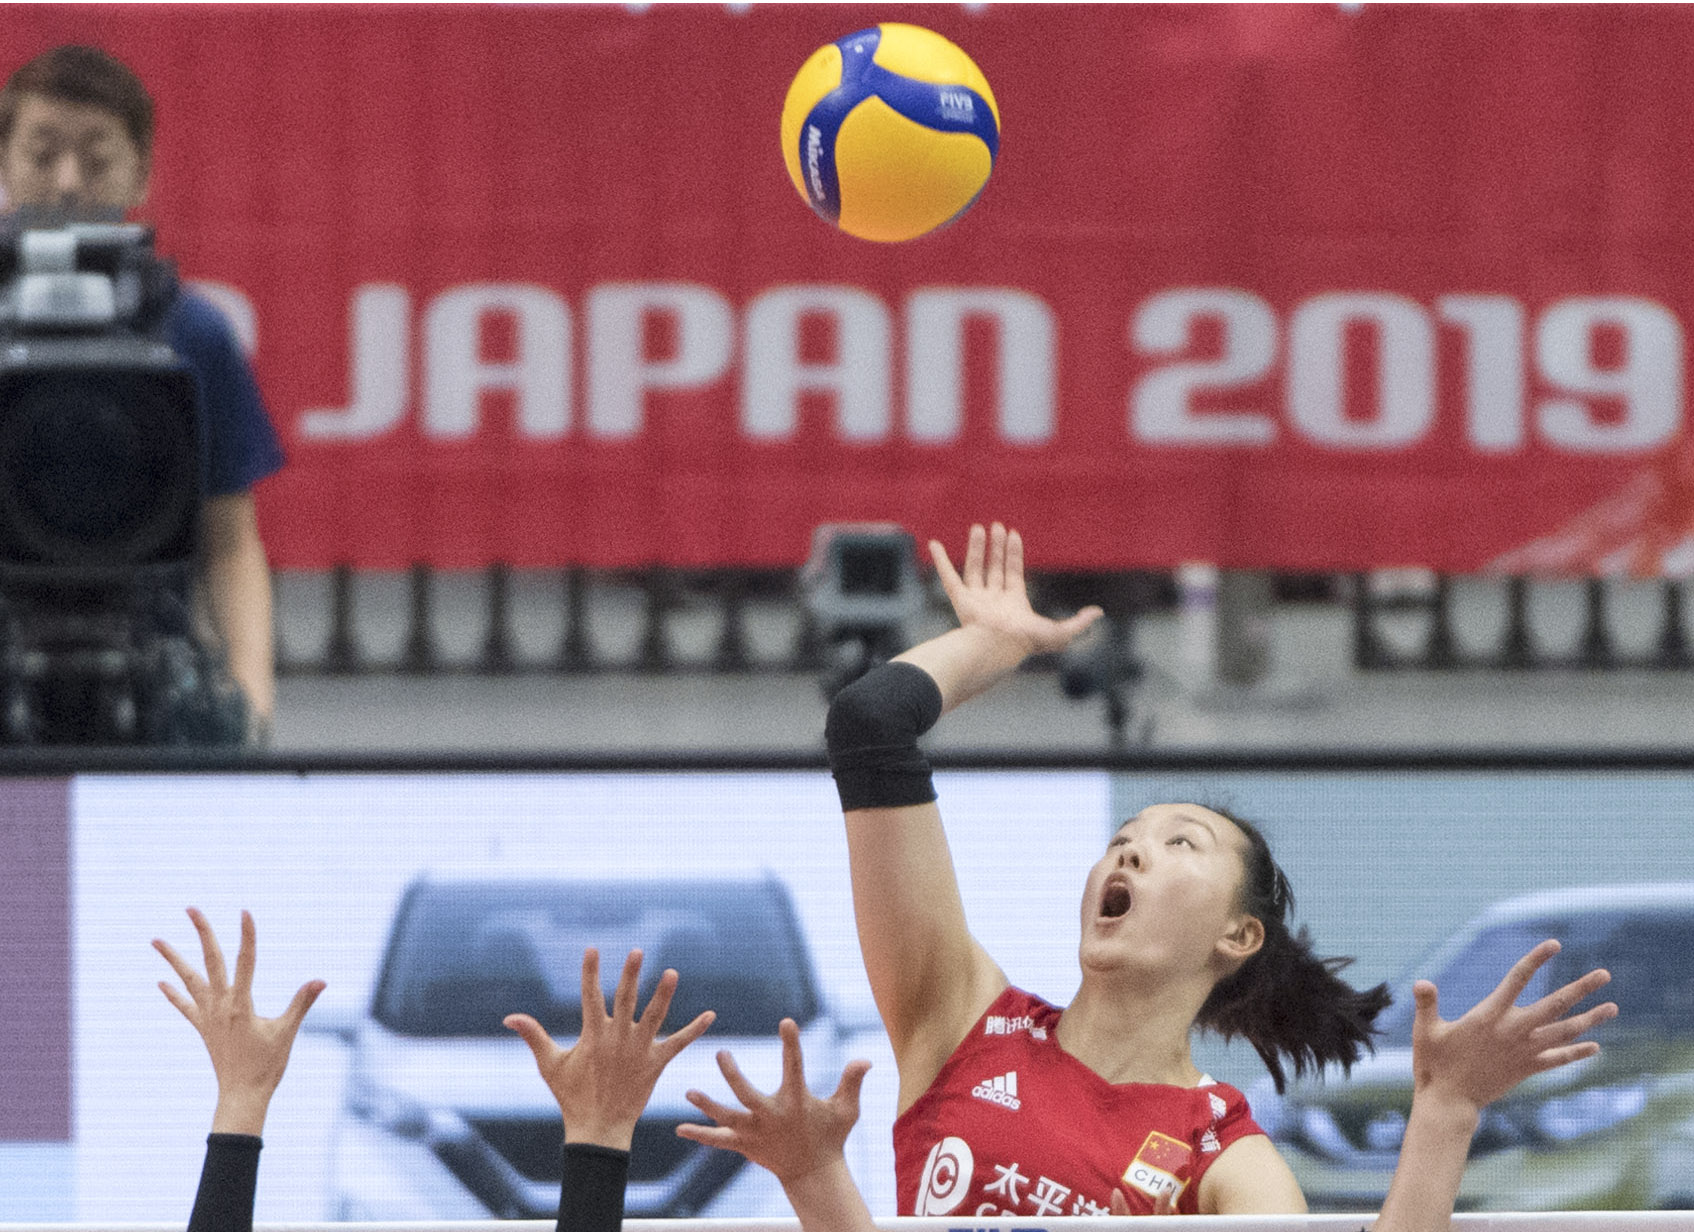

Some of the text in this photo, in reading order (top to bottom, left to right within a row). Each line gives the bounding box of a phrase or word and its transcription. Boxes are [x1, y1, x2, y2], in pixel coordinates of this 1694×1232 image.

[293, 281, 1057, 446] JAPAN
[1128, 286, 1684, 454] 2019
[971, 1085, 1022, 1111] adidas
